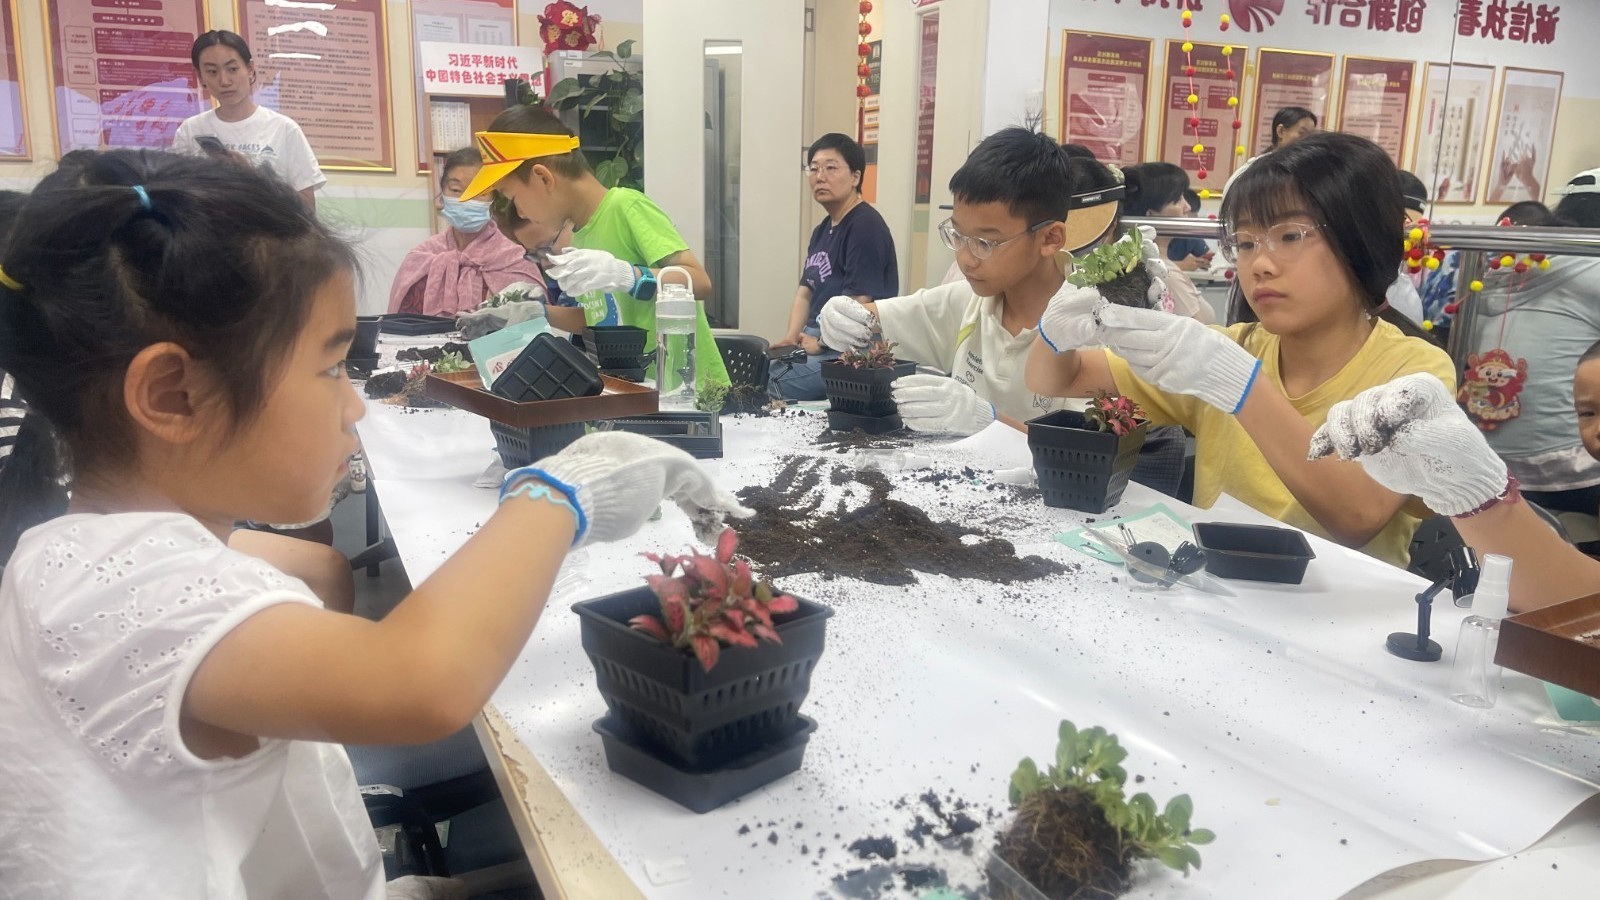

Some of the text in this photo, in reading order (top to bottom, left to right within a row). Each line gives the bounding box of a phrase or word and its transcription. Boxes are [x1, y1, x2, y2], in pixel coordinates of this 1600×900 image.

[448, 53, 518, 69] 习近平新时代
